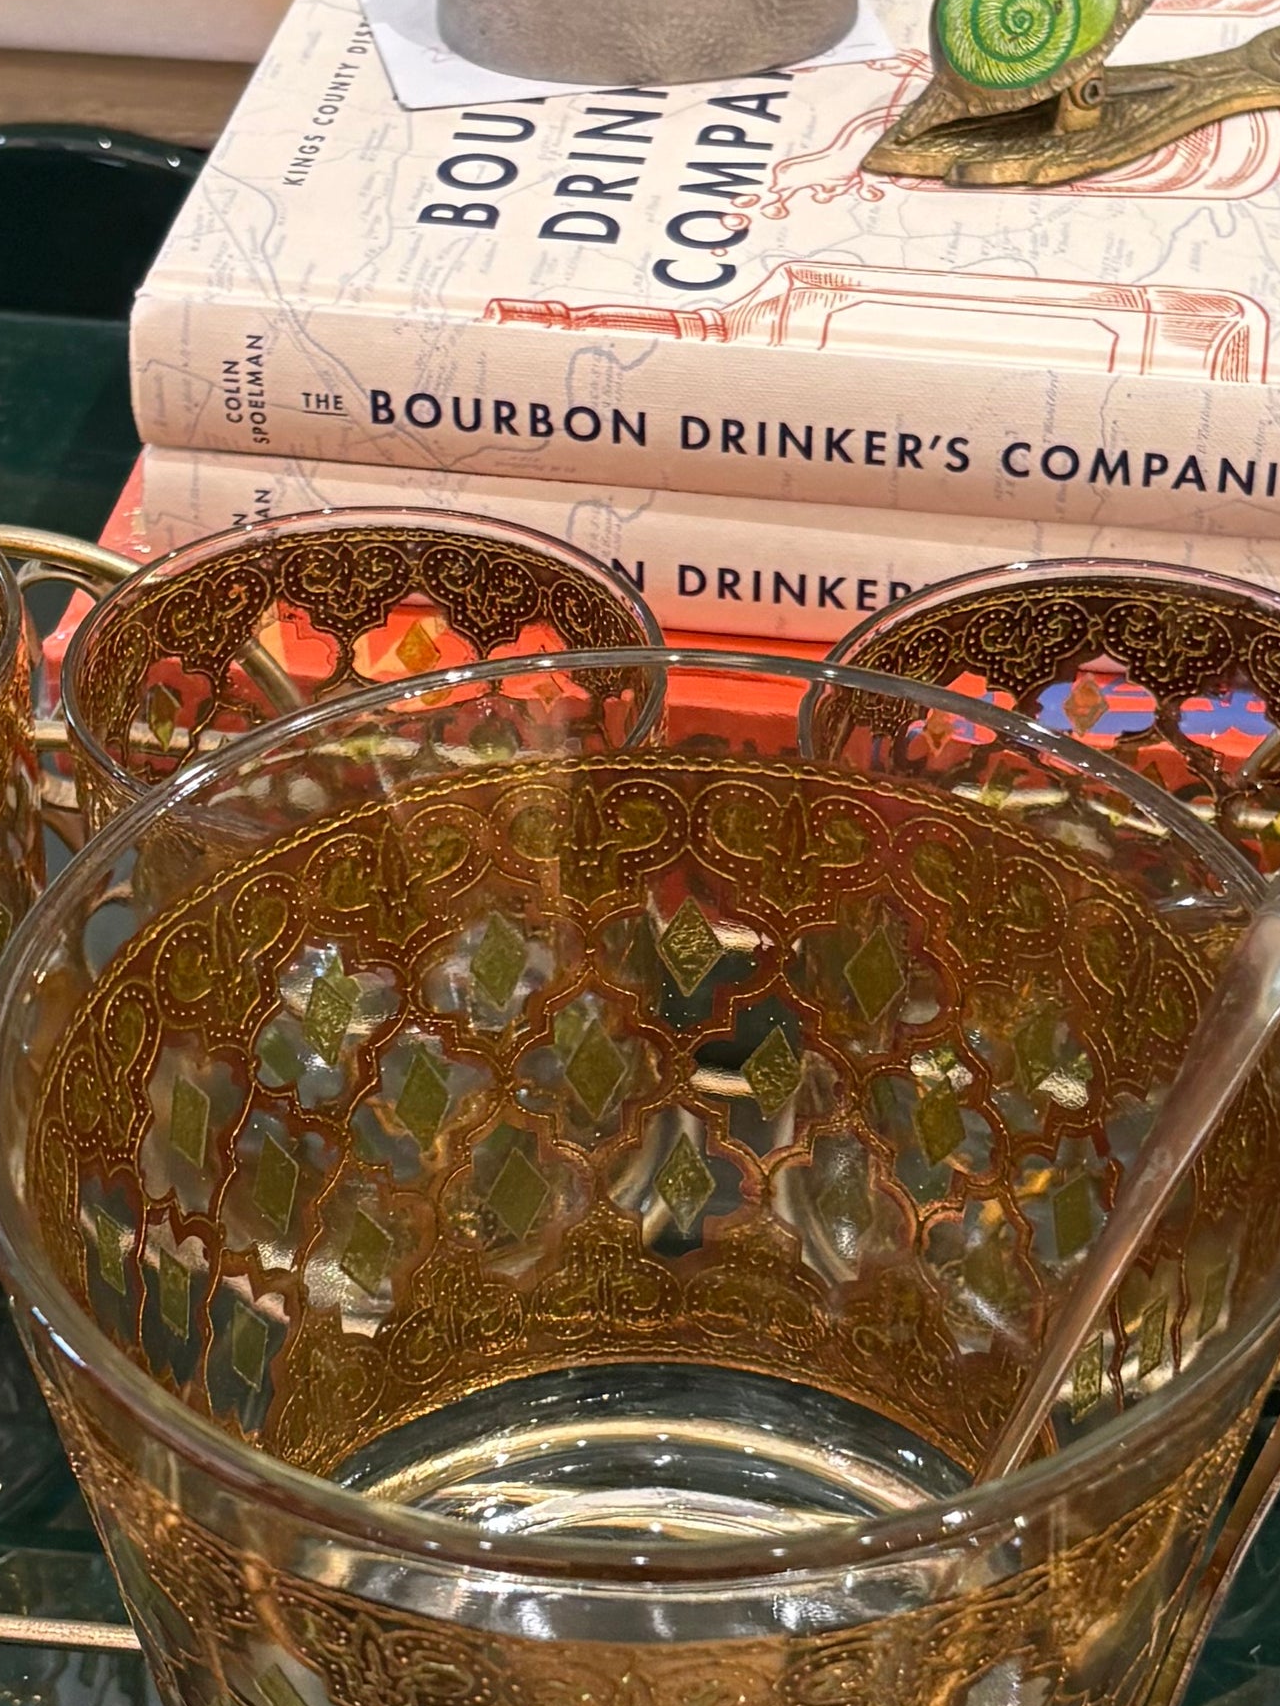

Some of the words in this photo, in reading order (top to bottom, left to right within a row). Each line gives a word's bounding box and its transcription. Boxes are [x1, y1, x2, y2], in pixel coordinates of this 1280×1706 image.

[282, 134, 326, 187] KINGS
[312, 62, 361, 127] COUNTY
[416, 97, 547, 230] BOU
[537, 87, 670, 244] DRIN
[651, 71, 795, 291] COMPA
[222, 359, 242, 424] COLIN
[245, 333, 271, 445] SPOELMAN
[301, 392, 345, 410] THE
[370, 388, 648, 447] BOURBON
[680, 415, 971, 474] DRINKER'S
